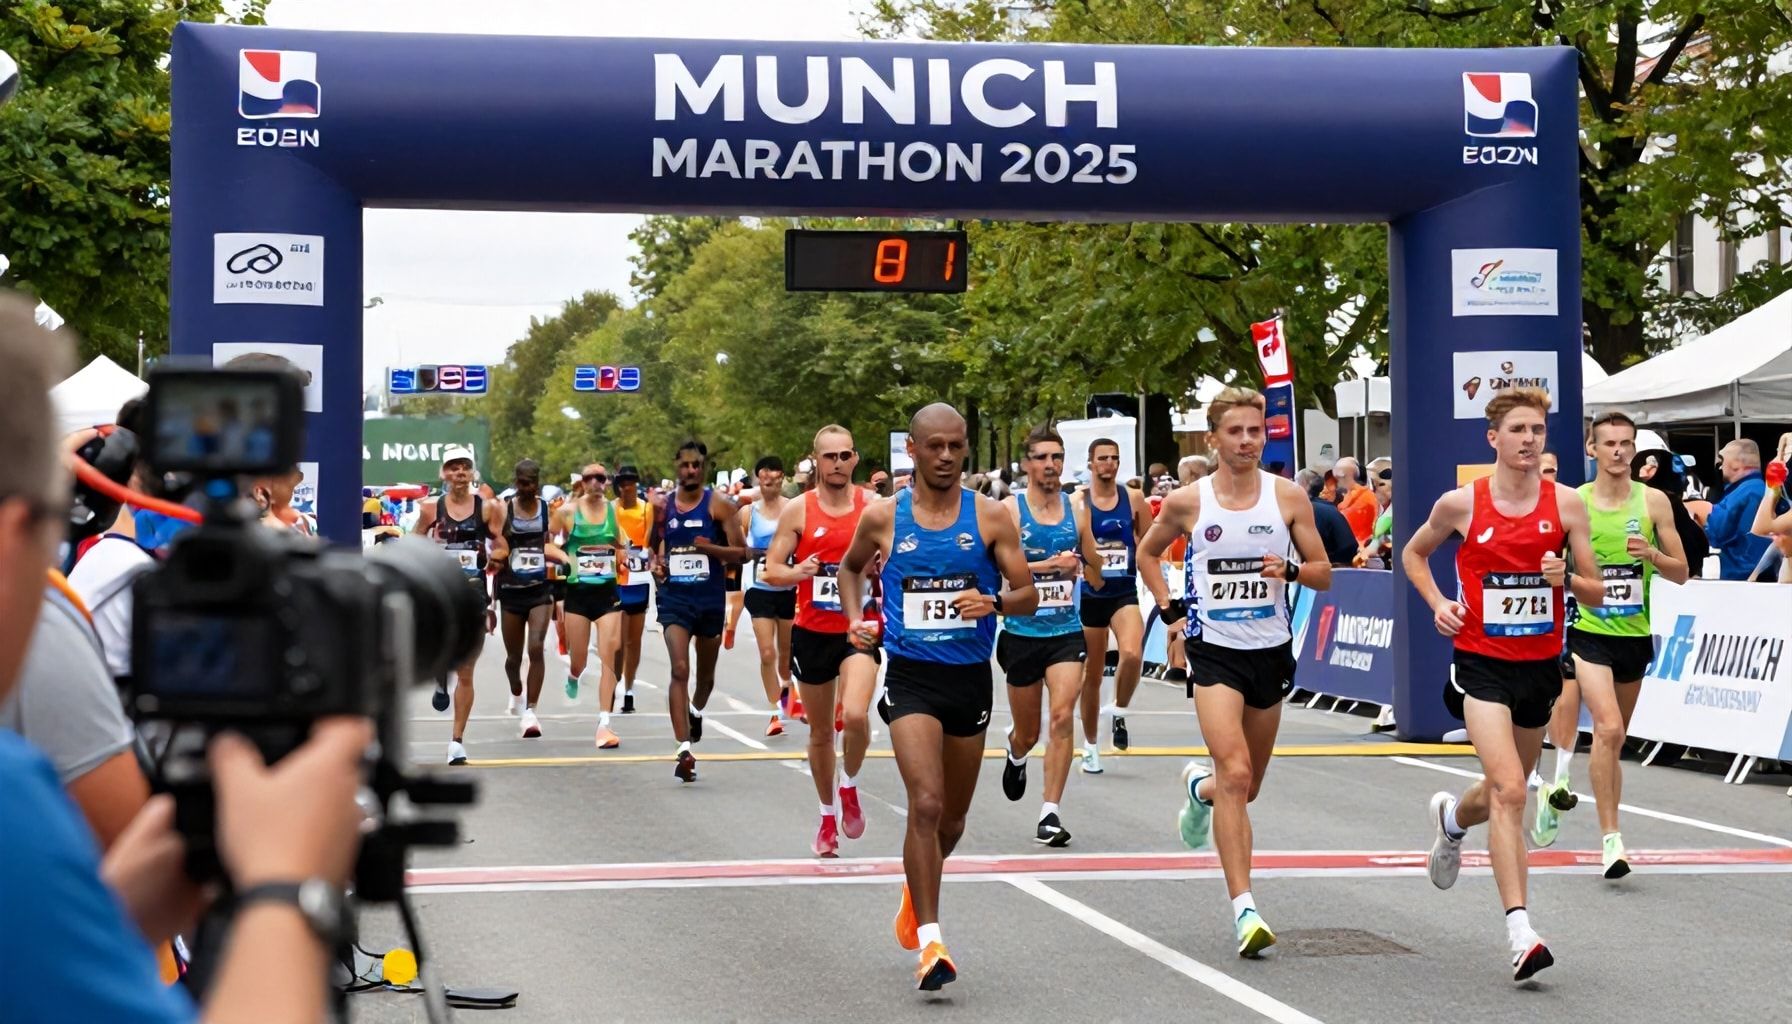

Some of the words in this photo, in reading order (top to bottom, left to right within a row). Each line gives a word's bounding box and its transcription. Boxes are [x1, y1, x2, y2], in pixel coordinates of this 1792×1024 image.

[654, 54, 1118, 128] MUNICH
[652, 138, 983, 182] MARATHON
[1000, 142, 1138, 184] 2025
